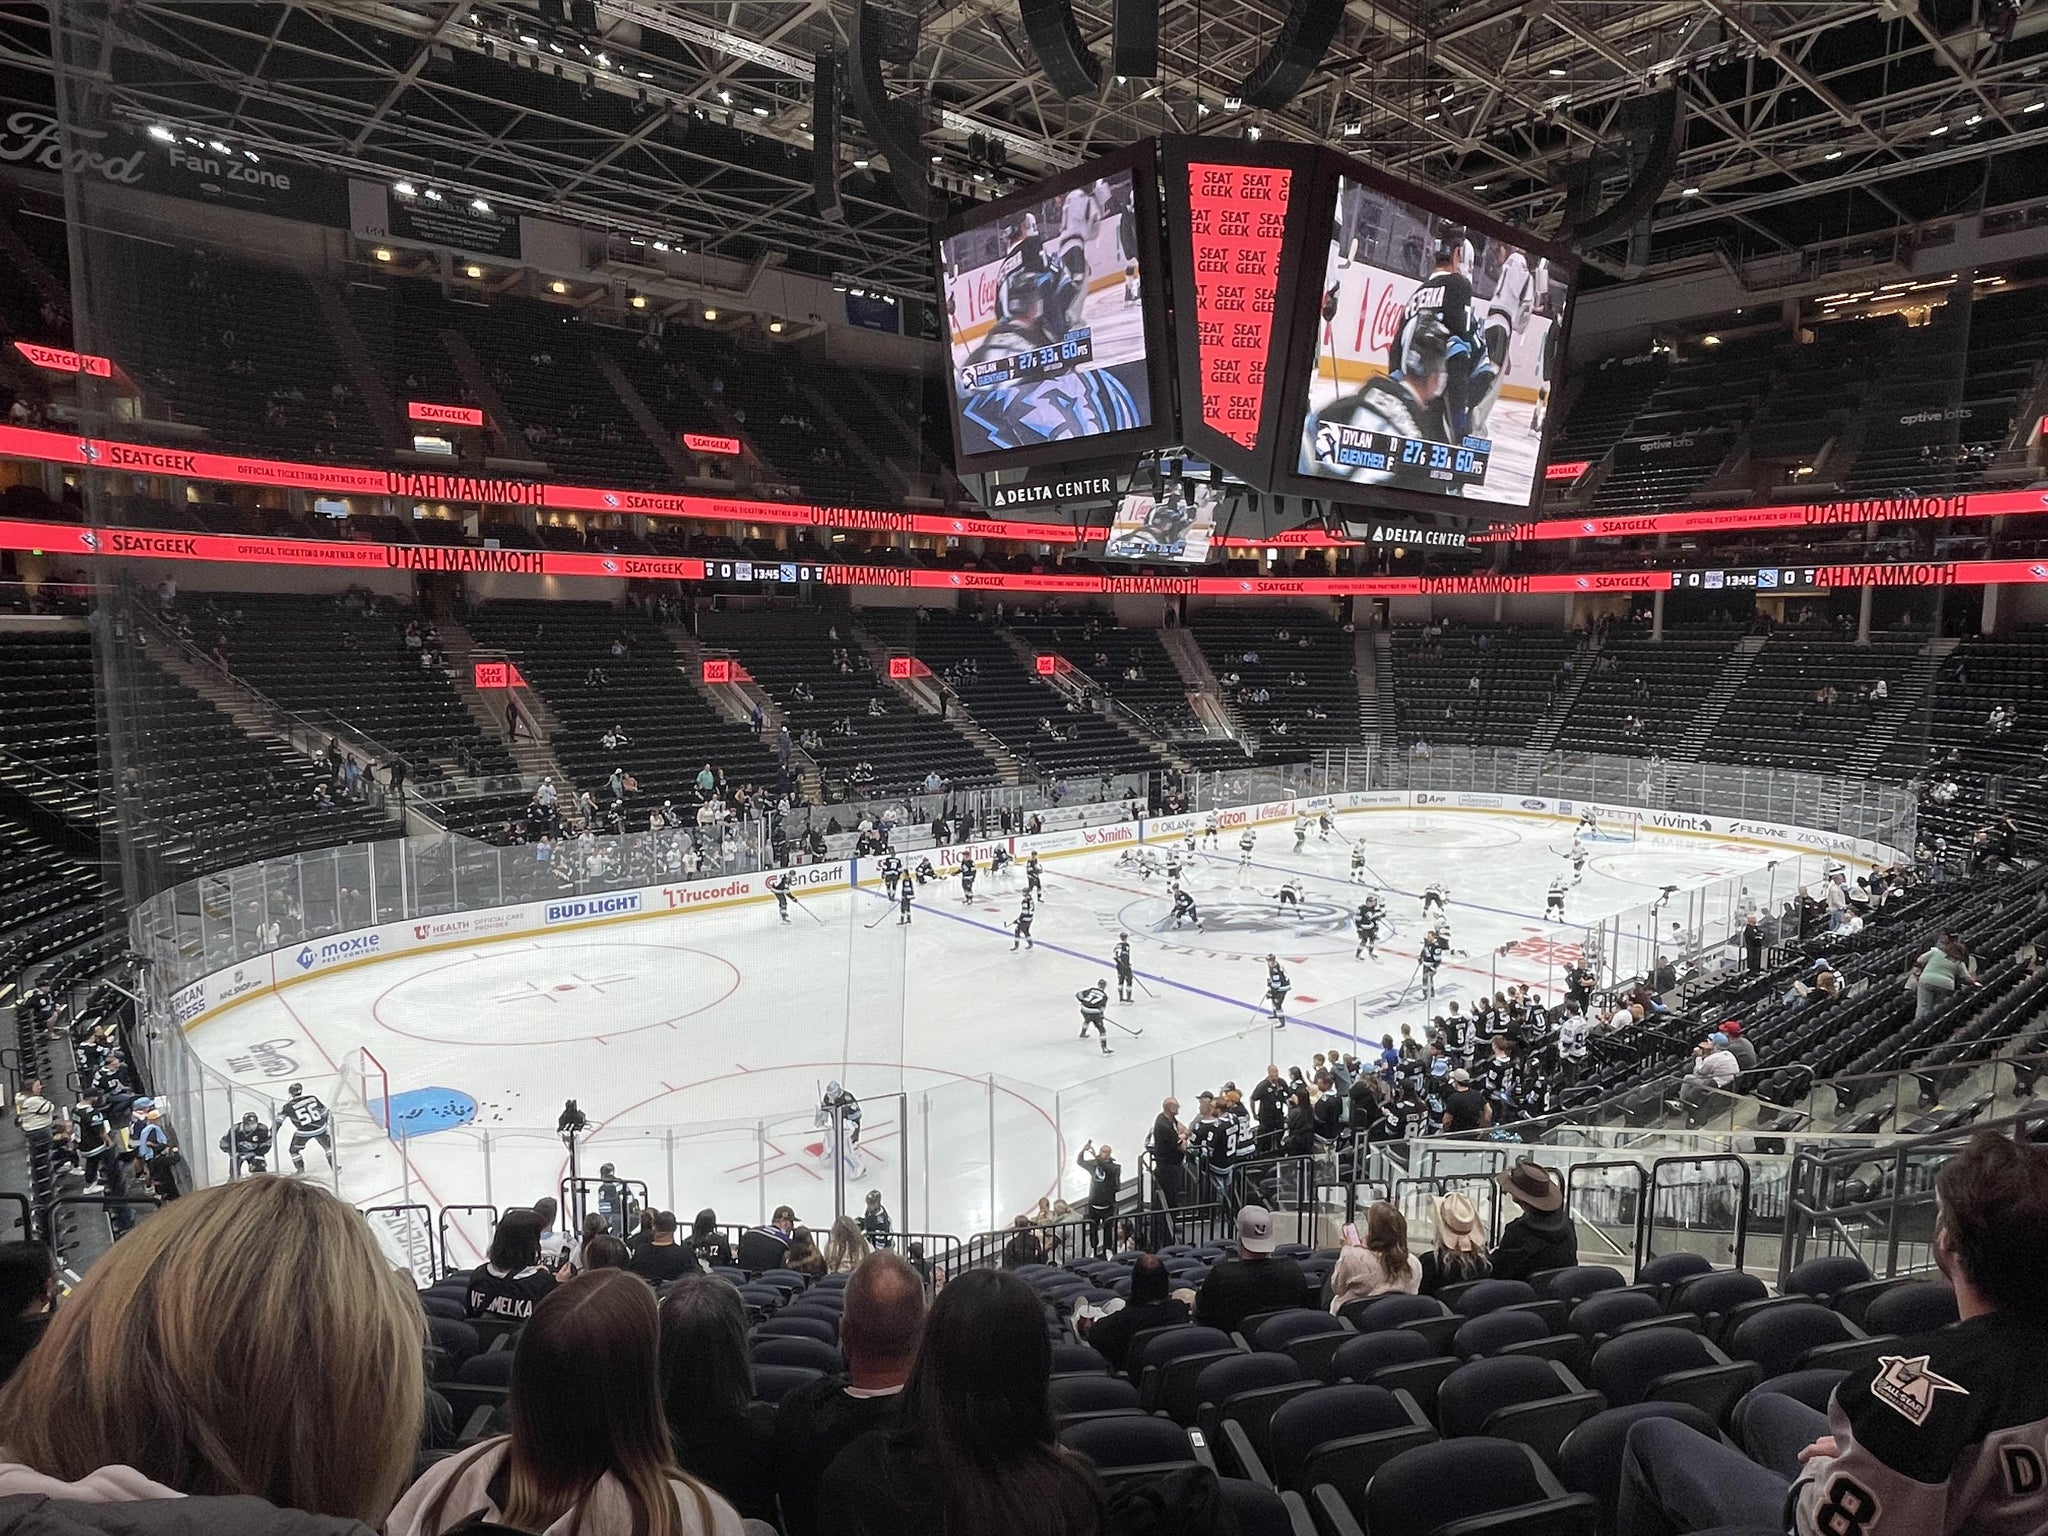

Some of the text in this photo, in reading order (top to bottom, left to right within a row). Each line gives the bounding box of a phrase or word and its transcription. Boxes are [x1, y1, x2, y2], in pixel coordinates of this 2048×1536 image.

[0, 111, 146, 184] Ford
[169, 148, 291, 191] Fan Zone
[1203, 171, 1272, 187] SEAT SEAT
[1201, 185, 1233, 198] GEEK
[1240, 187, 1272, 201] GEEK
[1220, 210, 1250, 224] SEAT
[1218, 223, 1250, 237] GEEK
[1199, 247, 1267, 262] SEAT SEAT
[1197, 260, 1267, 276] GEEK GEEK
[1217, 285, 1245, 299] SEAT
[1214, 299, 1245, 312] GEEK
[1234, 323, 1262, 337] SEAT
[1231, 336, 1262, 349] GEEK
[976, 362, 997, 376] DYLAN
[1213, 359, 1241, 372] SEAT
[1210, 372, 1241, 384] GEEK
[1229, 396, 1257, 408] SEAT
[420, 407, 471, 422] SEATGEEK
[1227, 408, 1257, 421] GEEK
[692, 437, 731, 450] SEATGEEK
[1341, 427, 1373, 449] DYLAN
[111, 447, 198, 473] SEATGEEK
[1339, 448, 1395, 471] GUENTHER F
[237, 465, 384, 487] OFFICIAL TICKETING PARTNER OF THE
[385, 471, 545, 505] UTAH MAMMOTH
[1007, 477, 1111, 504] DELTA CENTER
[626, 496, 686, 513] SEATGEEK
[1804, 496, 1968, 525] UTAH MAMMOTH
[811, 506, 914, 532] UTAH MAMMOTH
[1602, 518, 1658, 532] SEATGEEK
[967, 522, 1008, 535] SEATGEEK
[112, 534, 198, 555] SEATGEEK
[1385, 529, 1424, 545] DELTA
[1425, 531, 1467, 547] CENTER
[237, 545, 383, 561] OFFICIAL TICKETING PARTNER OF THE
[385, 546, 544, 573] UTAH MAMMOTH
[625, 560, 684, 575] SEATGEEK
[721, 563, 731, 578] 0
[753, 568, 780, 580] 13:45
[800, 567, 810, 580] 0
[1850, 564, 1957, 586] MAMMOTH
[848, 567, 912, 587] MAMMOTH
[965, 576, 1005, 587] SEATGEEK
[1101, 578, 1131, 594] UTAH
[1134, 577, 1199, 594] MAMMOTH
[1419, 576, 1530, 593] UTAH MAMMOTH
[1595, 575, 1650, 588] SEATGEEK
[1689, 573, 1700, 587] 0
[1726, 575, 1757, 586] 13:45
[1784, 570, 1796, 584] 0
[1257, 581, 1304, 592] SEATGEEK
[1652, 812, 1698, 831] vivint
[1098, 826, 1133, 844] Smith's
[1797, 832, 1856, 852] ZIONS BAN
[809, 867, 843, 883] Garff
[676, 881, 750, 905] Trucordia
[549, 895, 639, 920] BUD LIGHT
[432, 920, 470, 933] HEALTH
[321, 946, 380, 964] PEST CONTROL
[299, 1102, 323, 1126] 56
[1226, 1133, 1237, 1157] 9
[1884, 1384, 1924, 1413] ALL-STAR
[2000, 1443, 2048, 1497] D
[1813, 1470, 1884, 1536] 8
